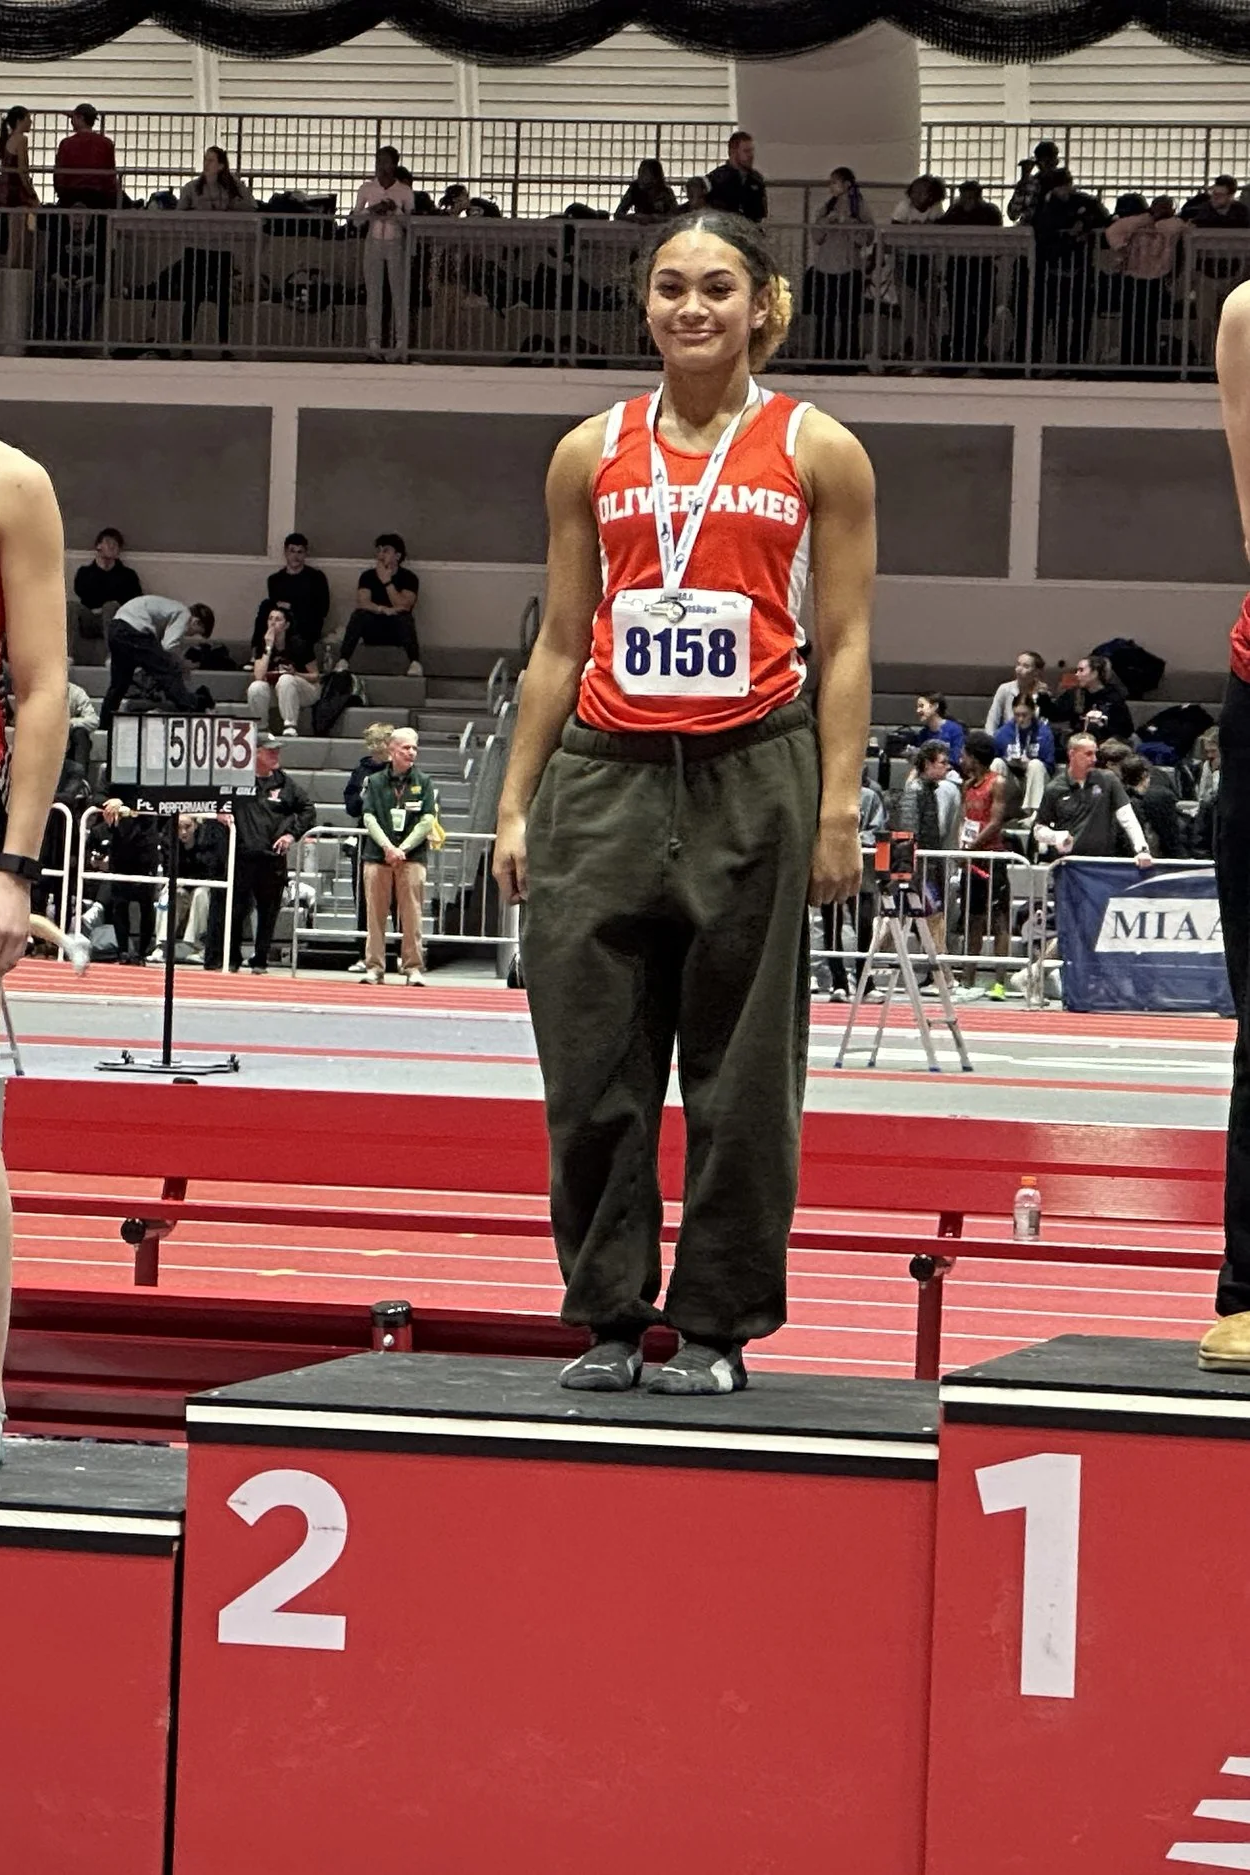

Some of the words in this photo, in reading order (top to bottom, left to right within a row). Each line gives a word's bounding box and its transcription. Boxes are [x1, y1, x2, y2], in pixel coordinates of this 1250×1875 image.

[710, 484, 800, 526] AMES
[625, 627, 737, 677] 8158
[218, 1469, 348, 1651] 2
[975, 1453, 1081, 1699] 1
